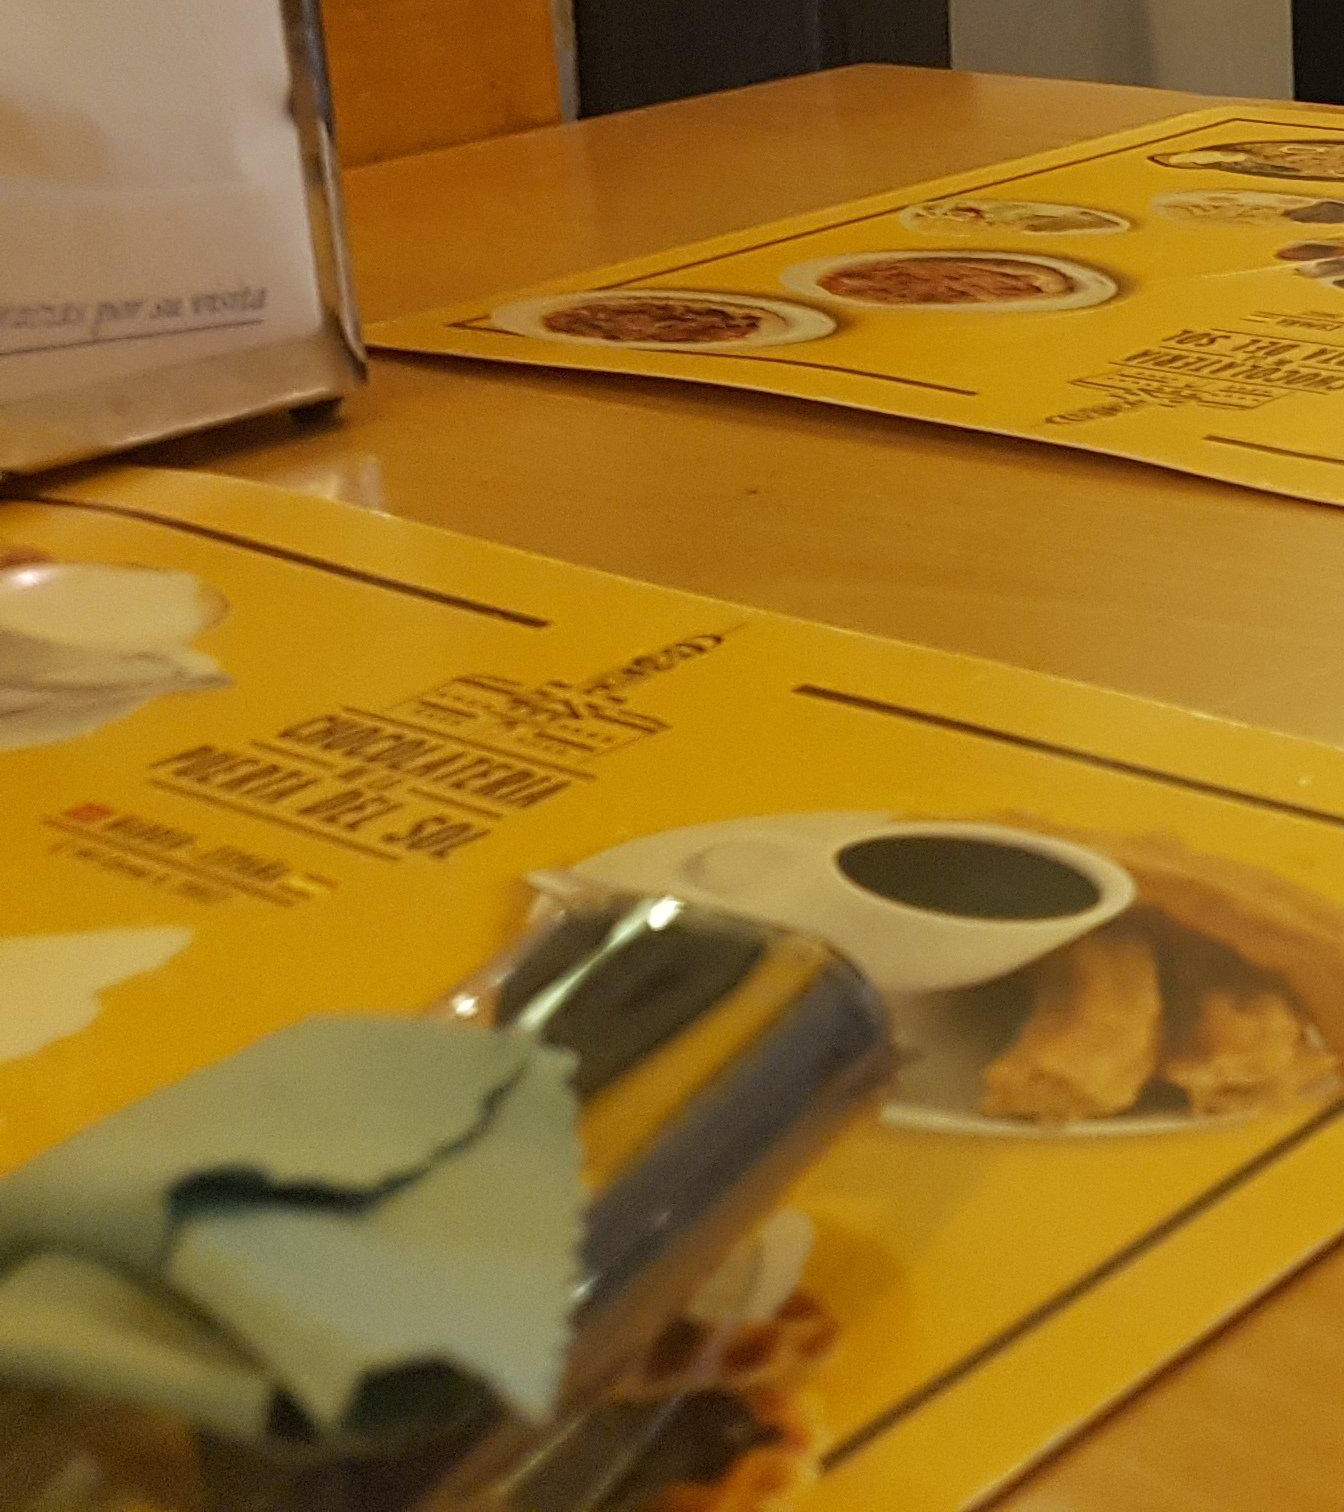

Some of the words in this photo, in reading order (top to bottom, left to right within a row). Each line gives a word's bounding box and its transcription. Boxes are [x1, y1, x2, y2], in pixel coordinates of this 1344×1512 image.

[1162, 328, 1232, 348] SOL
[1231, 338, 1301, 357] DEL
[380, 813, 491, 859] SOL
